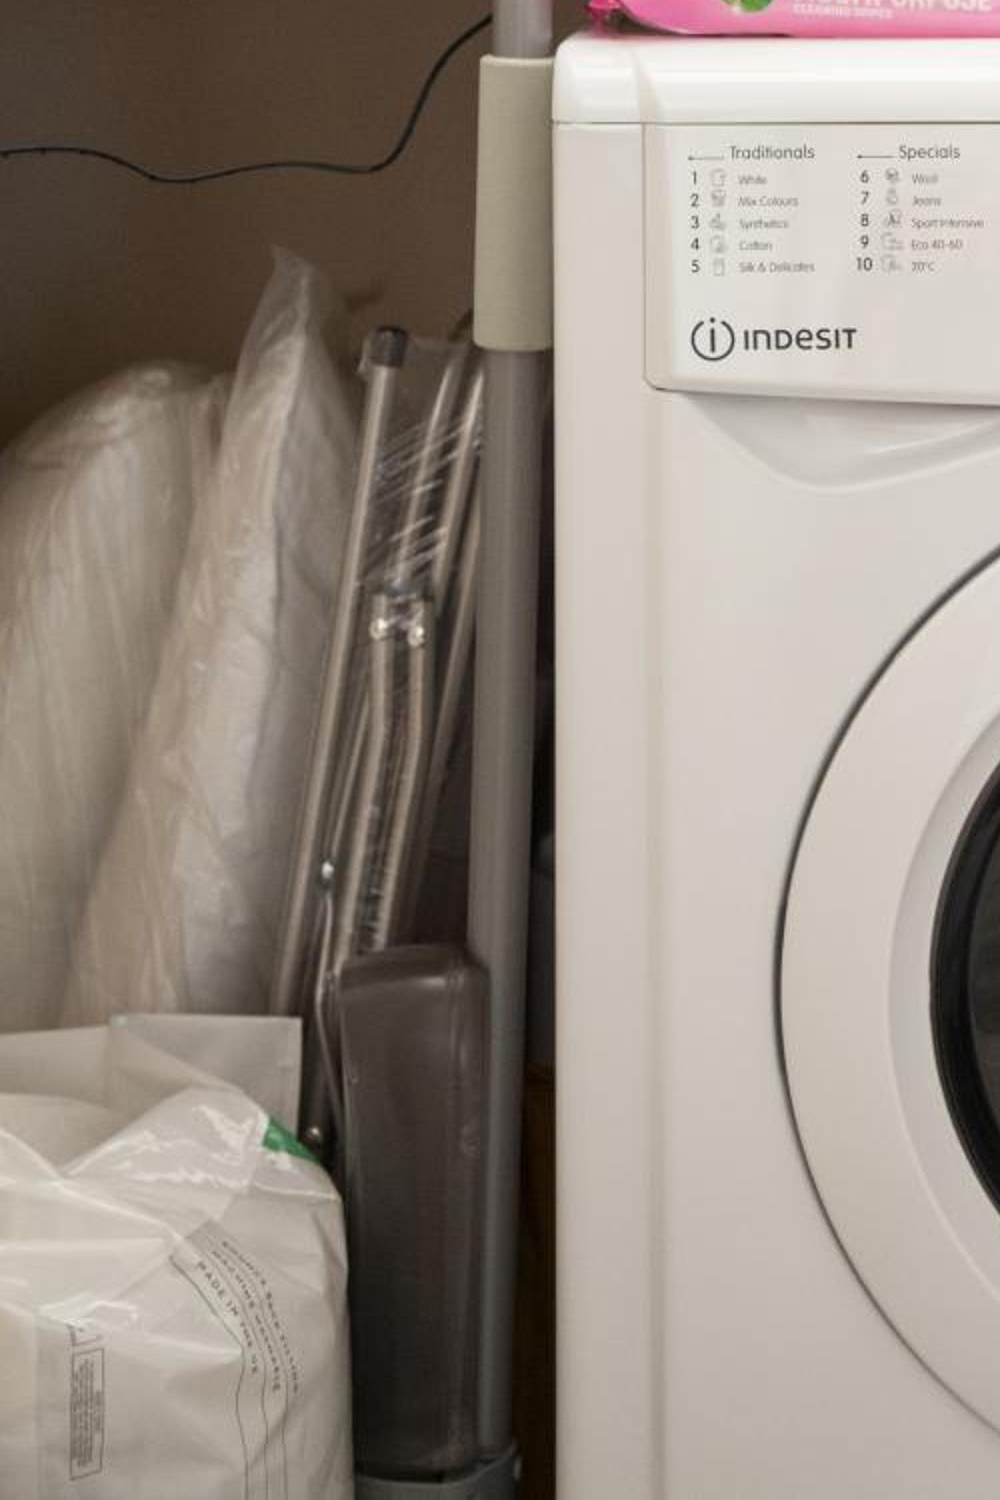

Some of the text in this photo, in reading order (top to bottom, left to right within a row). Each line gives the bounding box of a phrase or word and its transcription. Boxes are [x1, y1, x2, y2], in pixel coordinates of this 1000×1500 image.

[729, 143, 816, 160] Traditionals
[898, 144, 961, 161] Specials
[692, 170, 698, 185] 1
[859, 169, 869, 184] 6
[690, 192, 700, 207] 2
[860, 190, 870, 205] 7
[690, 215, 700, 230] 3
[860, 213, 870, 228] 8
[689, 237, 700, 252] 4
[860, 235, 870, 250] 9
[690, 259, 701, 273] 5
[856, 256, 873, 272] 10
